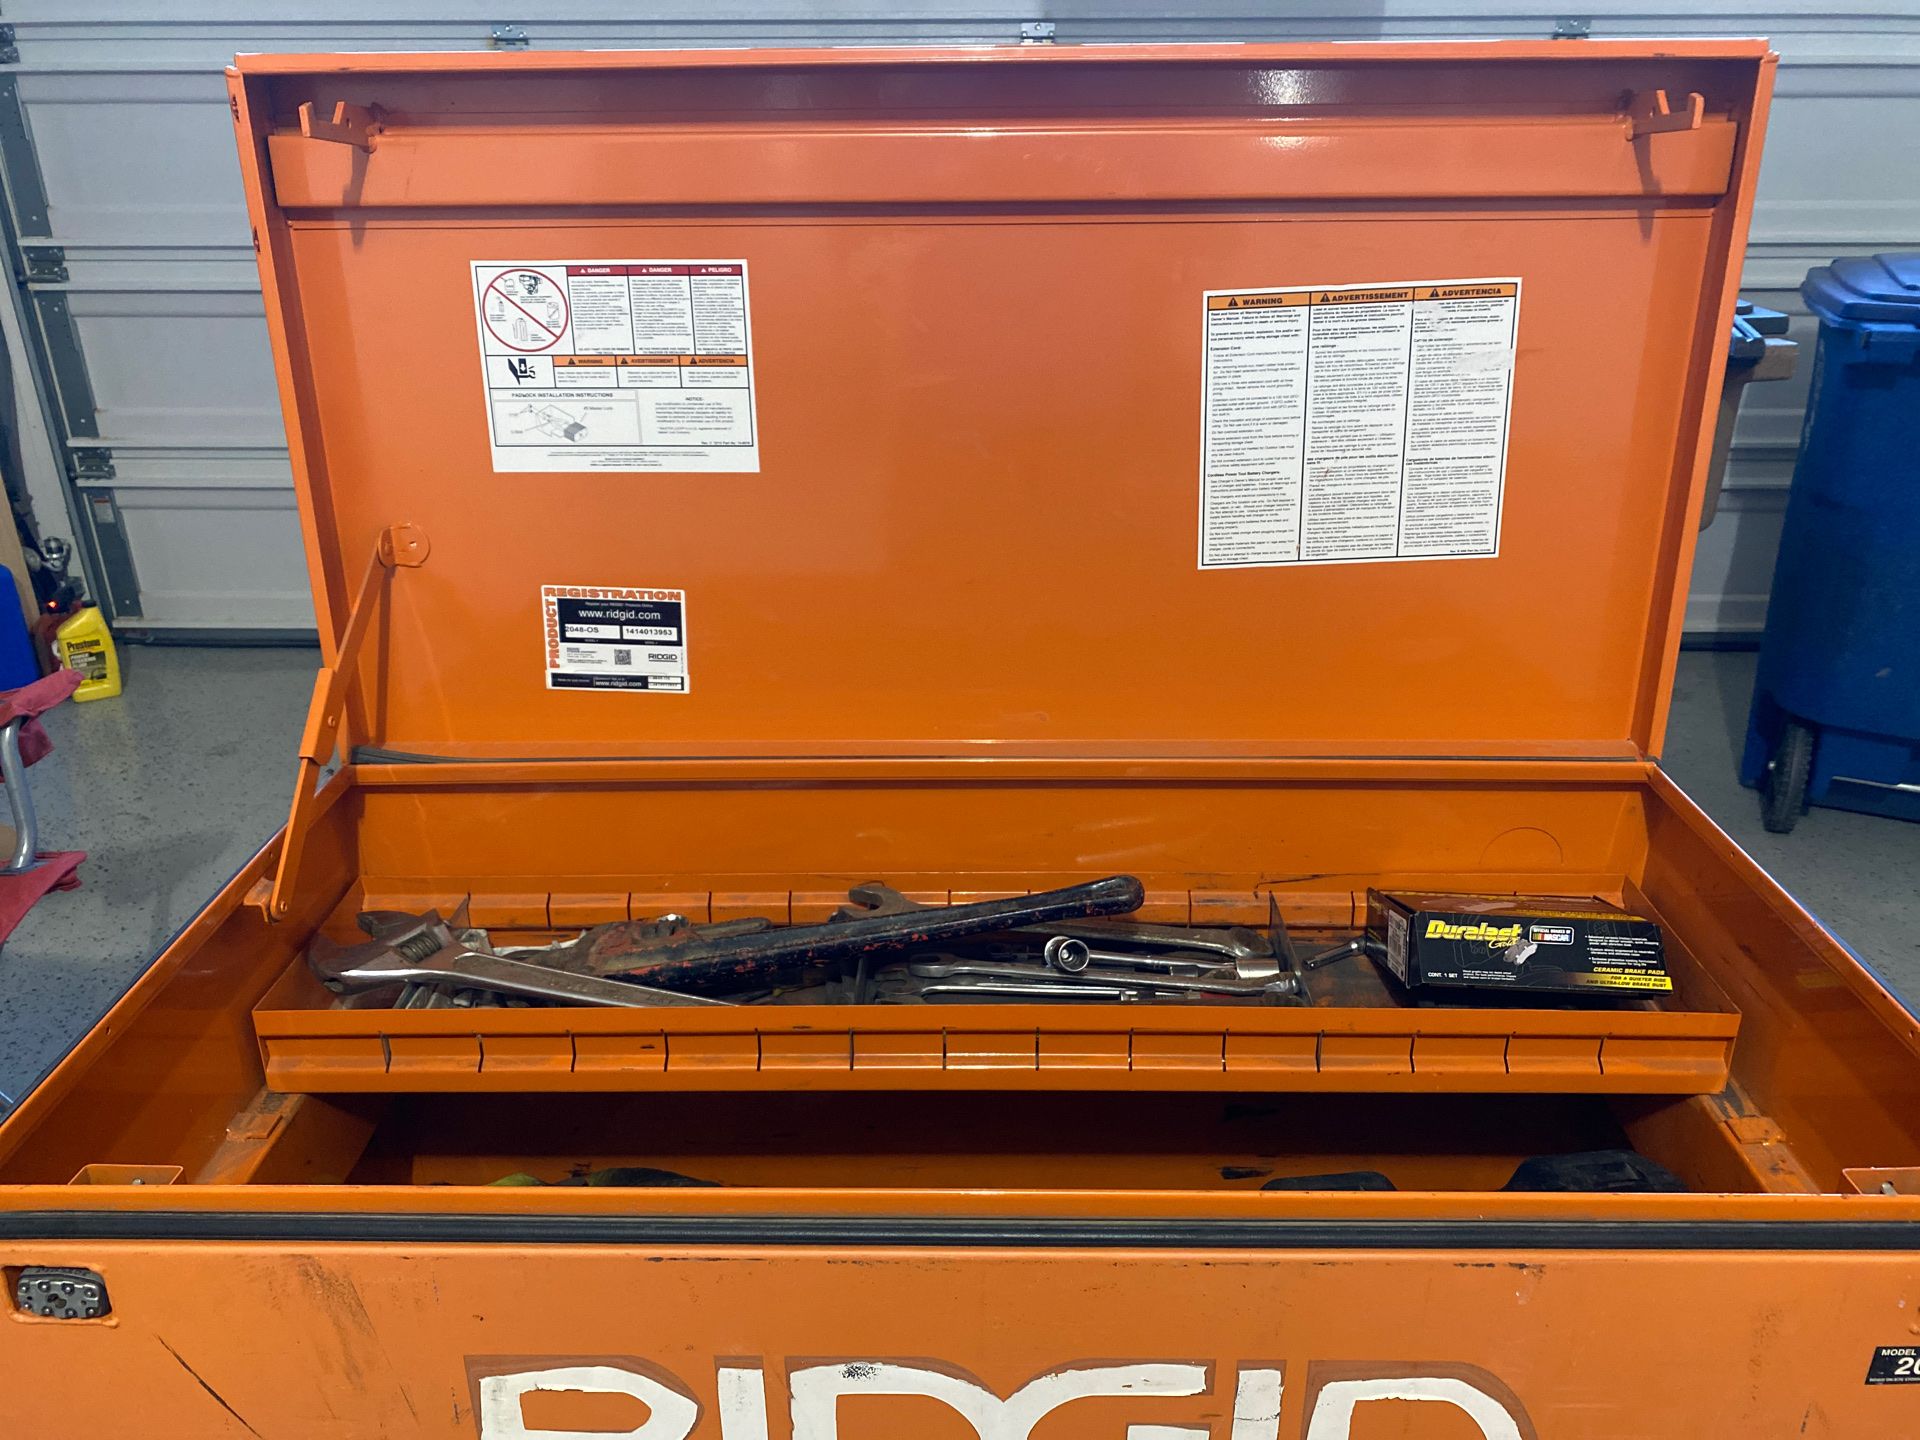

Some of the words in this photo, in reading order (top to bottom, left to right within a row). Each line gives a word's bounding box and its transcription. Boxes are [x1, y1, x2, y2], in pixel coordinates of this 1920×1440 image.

[1332, 292, 1409, 302] ADVERTISSEMENT
[1441, 288, 1502, 297] ADVERTENCIA
[1242, 297, 1283, 306] WARNING
[543, 587, 681, 601] REGISTRATION
[578, 609, 661, 621] www.ridgid.com
[545, 599, 560, 669] PRODUCT
[564, 626, 599, 634] 2048-OS
[594, 680, 642, 688] www.ridgid.com
[1425, 919, 1523, 942] Duralast
